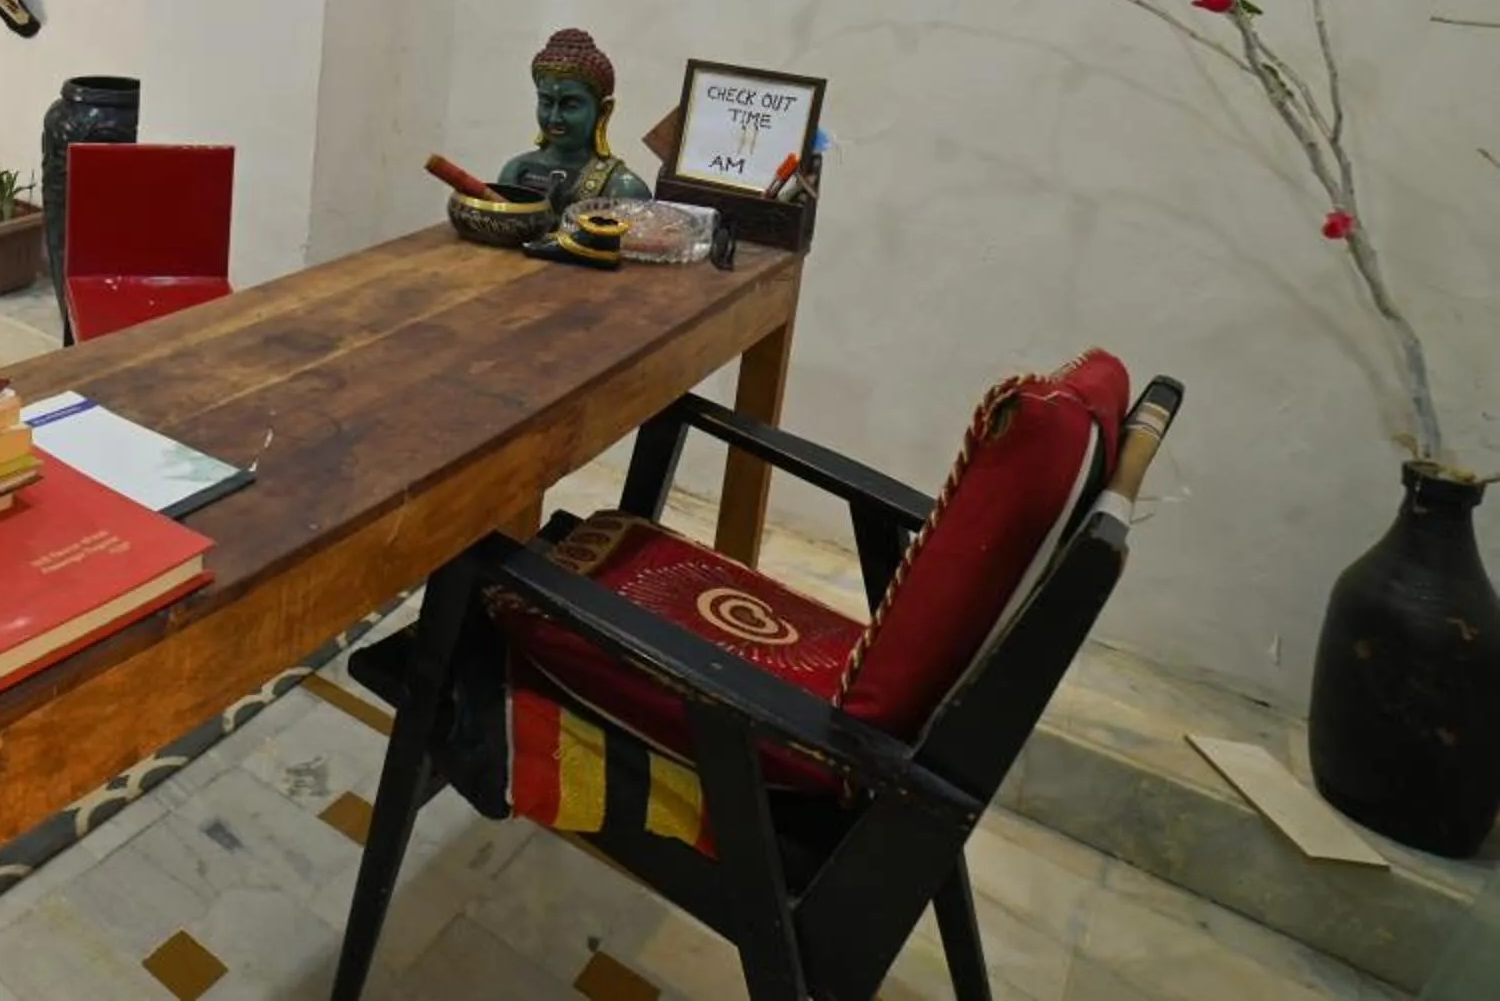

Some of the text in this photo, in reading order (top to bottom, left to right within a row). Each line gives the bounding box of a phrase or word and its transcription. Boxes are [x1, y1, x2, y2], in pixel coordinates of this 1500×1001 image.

[707, 86, 798, 112] CHECK OUT
[728, 108, 772, 129] TIME
[708, 154, 746, 174] AM
